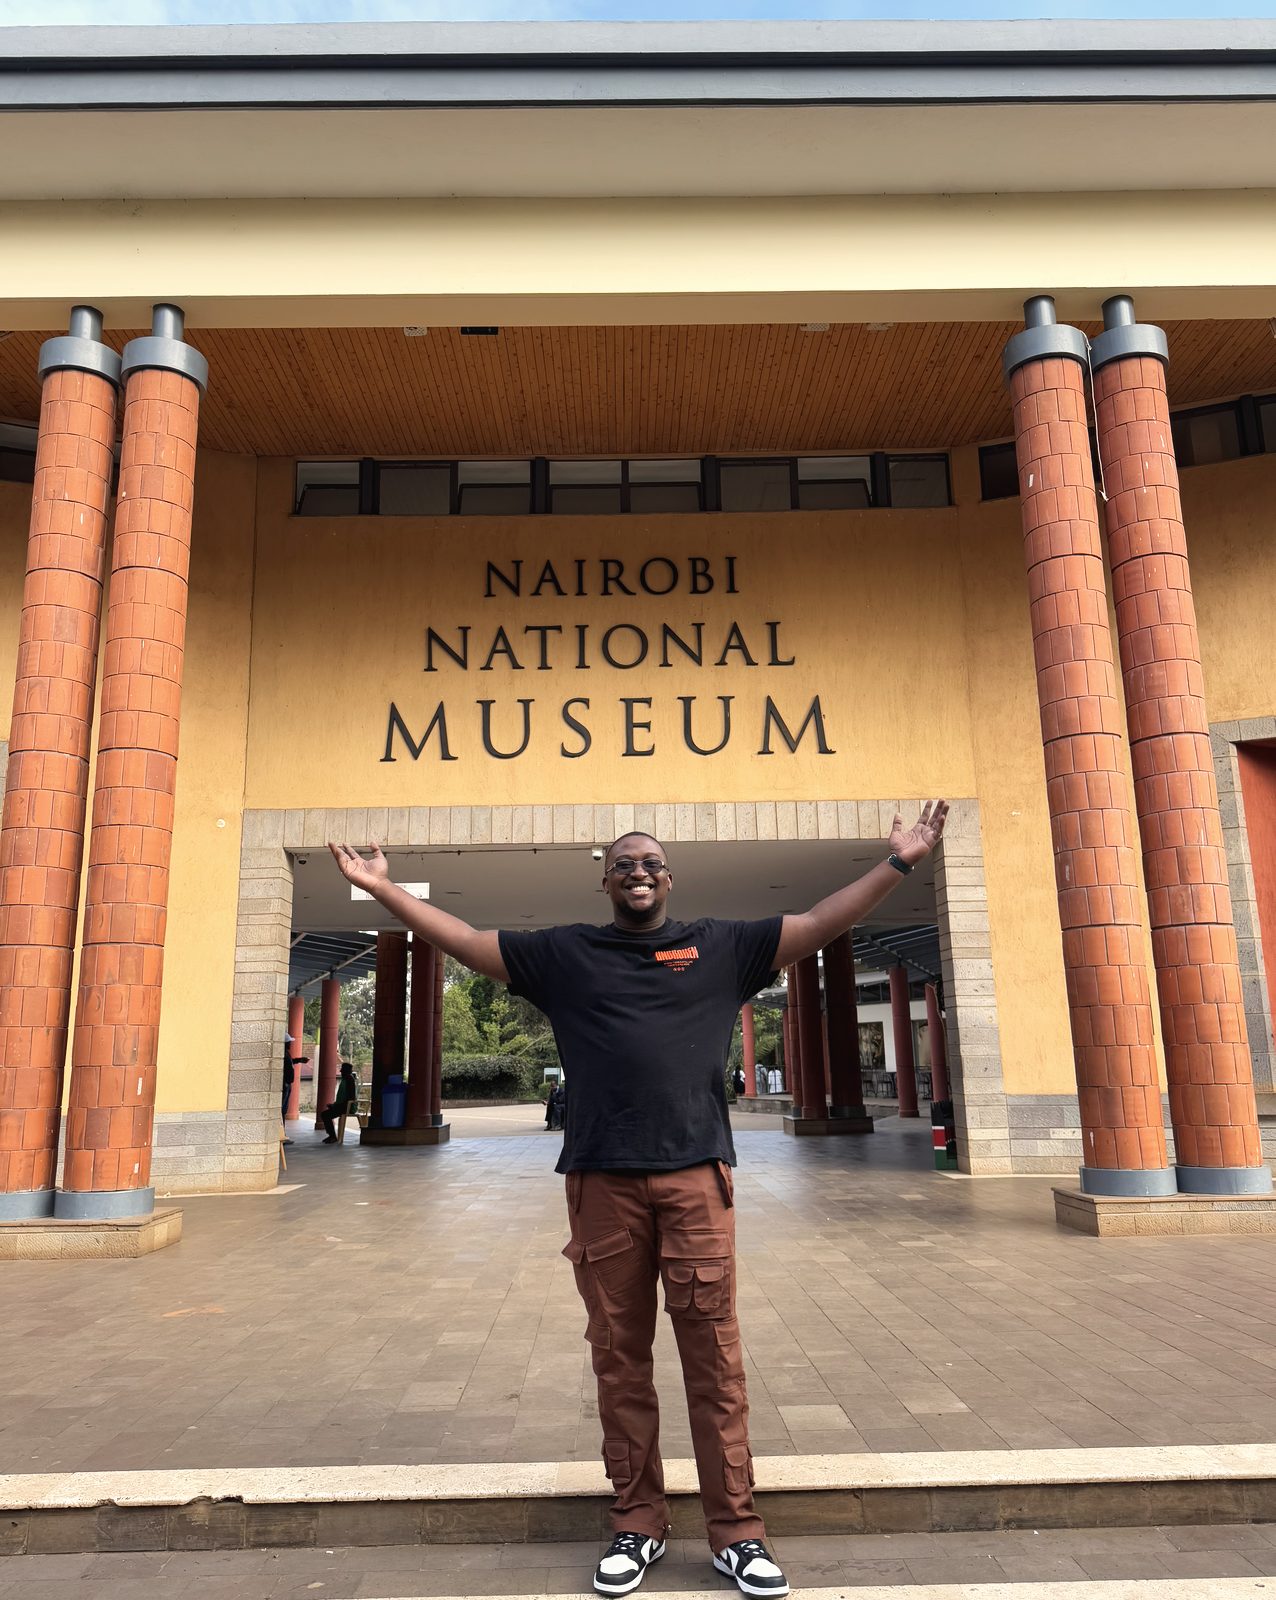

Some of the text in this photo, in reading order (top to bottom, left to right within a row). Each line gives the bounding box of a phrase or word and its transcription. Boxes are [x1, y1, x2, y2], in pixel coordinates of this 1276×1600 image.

[483, 556, 740, 598] NAIROBI
[423, 621, 796, 672] NATIONAL
[380, 694, 837, 762] MUSEUM
